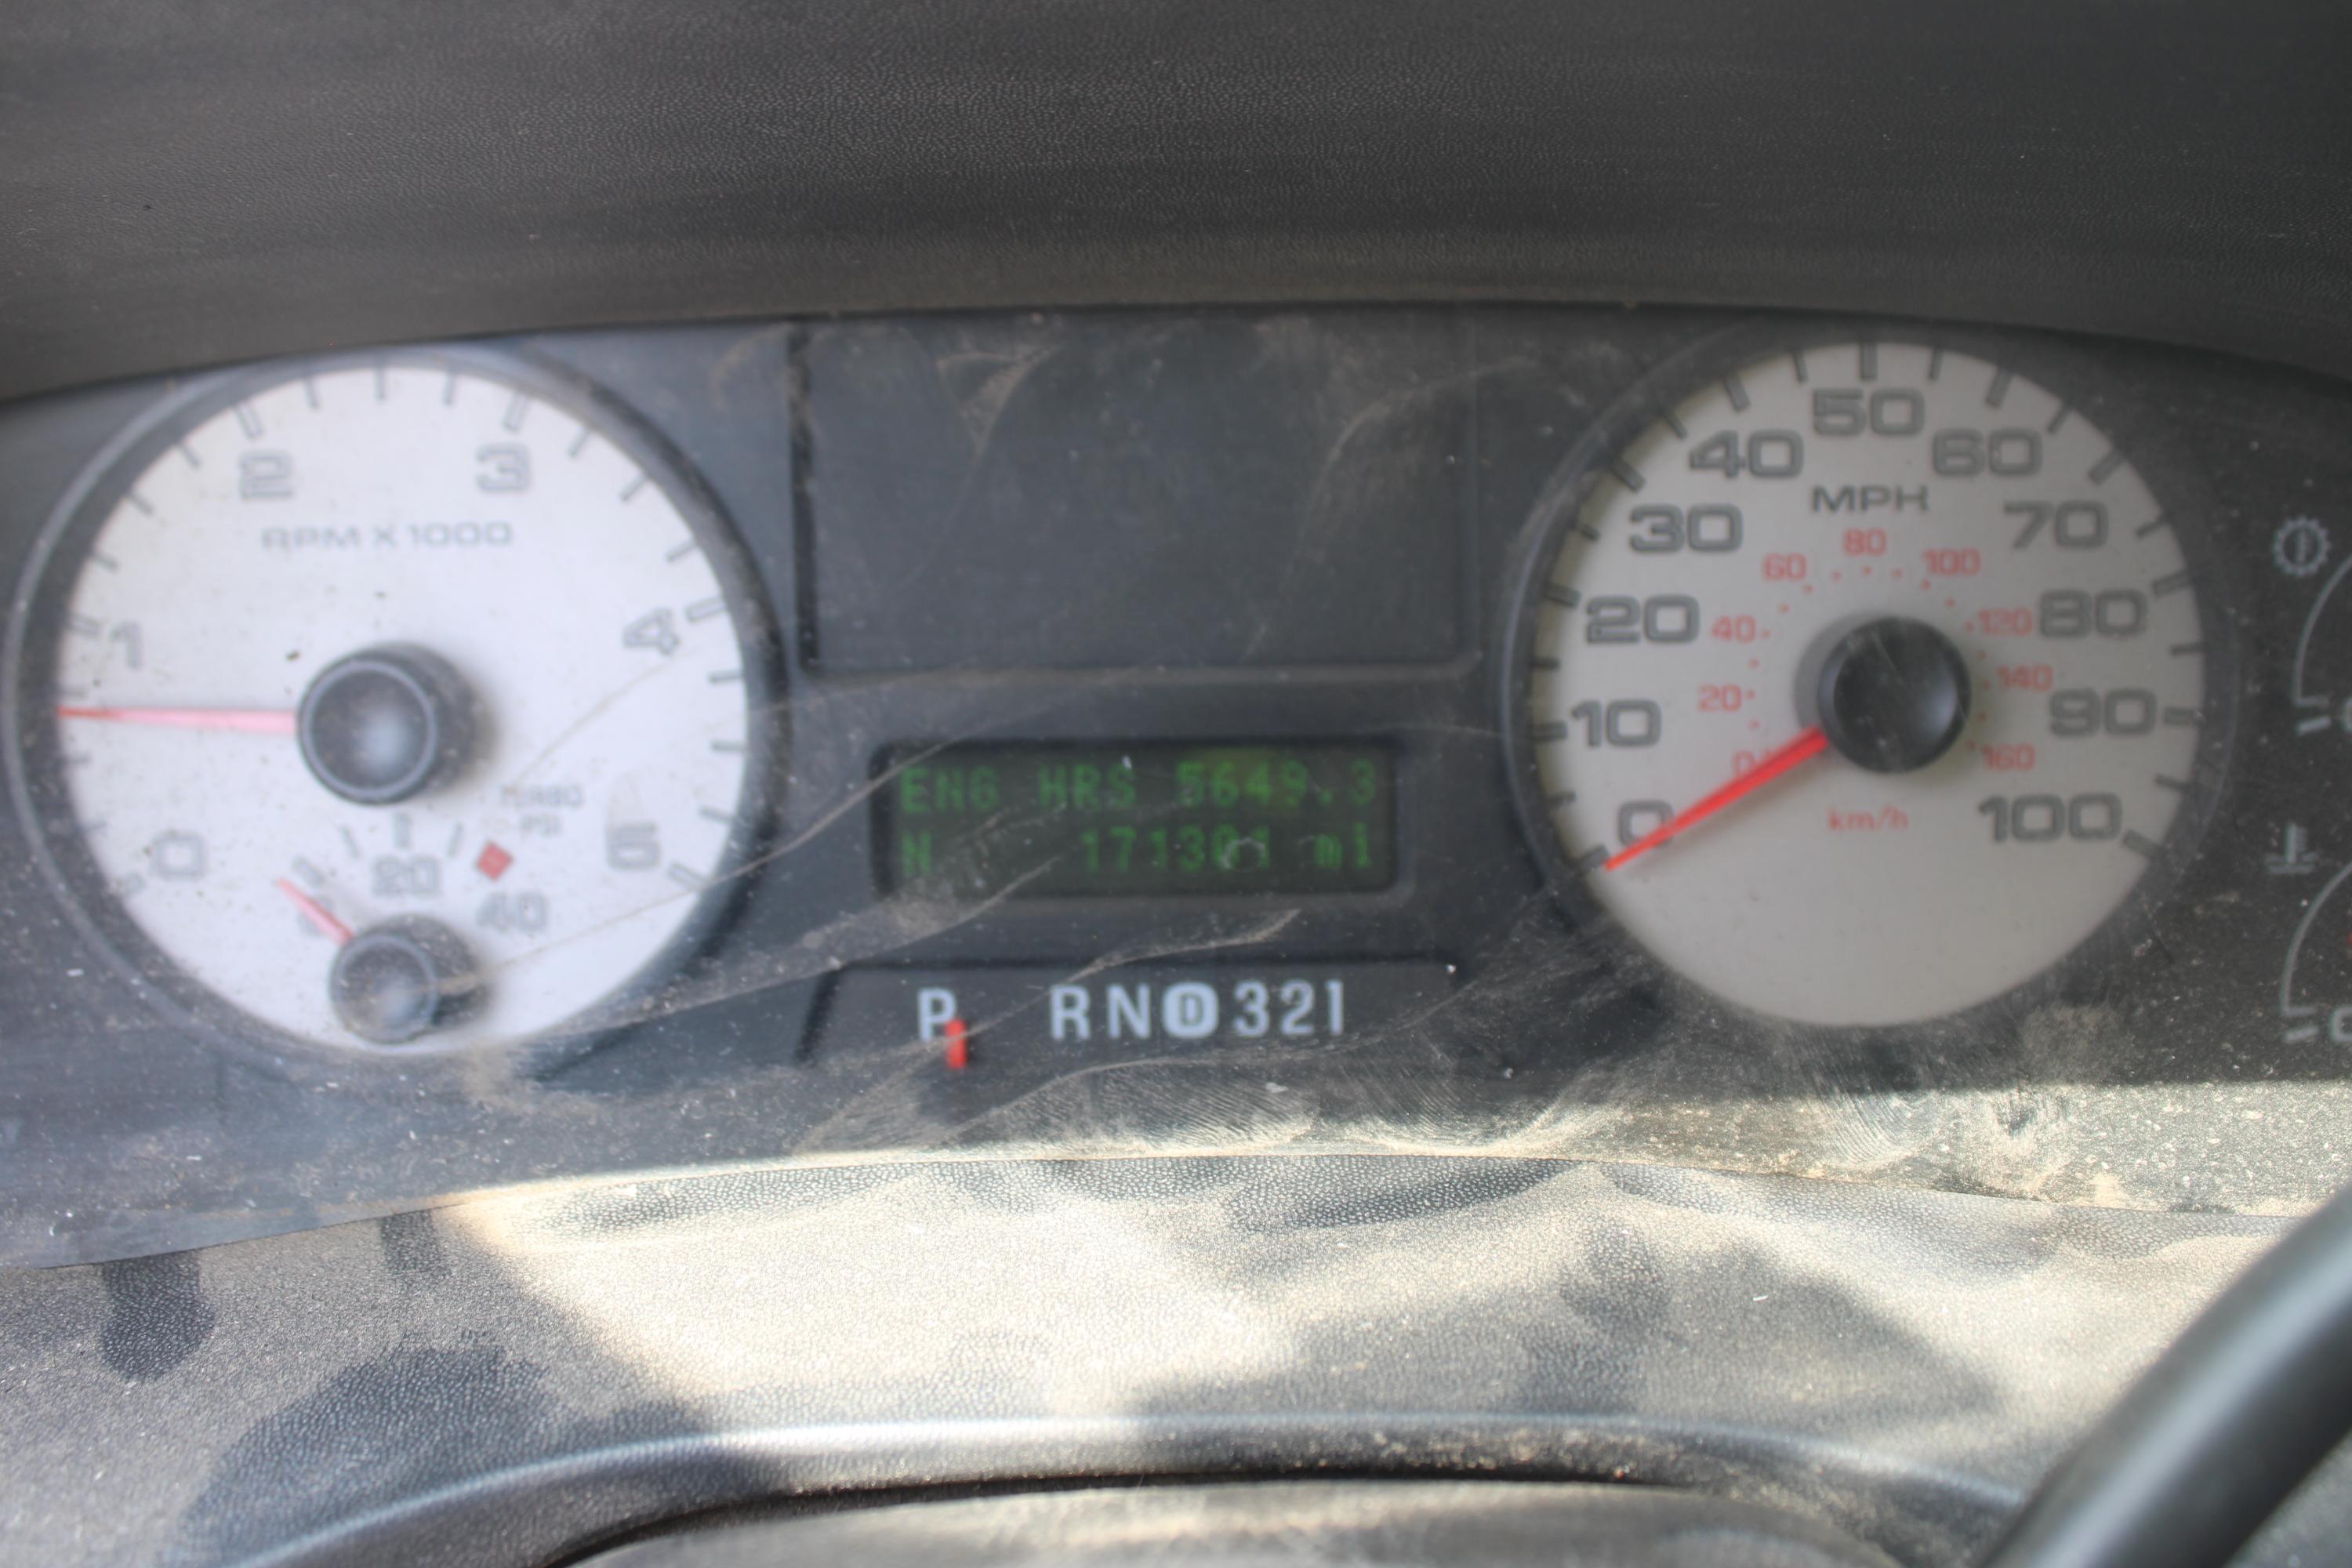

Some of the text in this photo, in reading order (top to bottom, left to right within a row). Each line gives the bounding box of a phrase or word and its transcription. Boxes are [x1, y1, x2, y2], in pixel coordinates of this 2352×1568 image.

[1813, 388, 1926, 437] 50
[240, 452, 293, 499] 2
[477, 445, 532, 492] 3
[1690, 428, 1805, 477] 40
[1933, 428, 2042, 476] 60
[1813, 486, 1928, 513] MPH
[263, 525, 361, 550] RPM
[411, 522, 514, 547] 1000
[1629, 504, 1743, 554] 30
[1845, 530, 1887, 557] 80
[2004, 500, 2109, 550] 70
[1763, 554, 1807, 582] 60
[1921, 549, 1980, 577] 100
[623, 609, 681, 655] 4
[1585, 595, 1700, 644] 20
[1711, 615, 1757, 643] 40
[1976, 608, 2034, 636] 120
[2039, 590, 2147, 639] 80
[110, 623, 143, 670] 1
[1699, 686, 1742, 712] 20
[1996, 665, 2053, 691] 140
[1571, 699, 1661, 747] 10
[2050, 688, 2157, 738] 90
[1983, 744, 2036, 771] 160
[899, 758, 1377, 814] ENG HRS 5649.3
[1618, 800, 1673, 845] 0
[1829, 806, 1908, 833] km/h
[1978, 793, 2123, 843] 100
[154, 833, 207, 881] 0
[372, 855, 441, 896] 20
[476, 891, 550, 932] 40
[916, 988, 957, 1041] P
